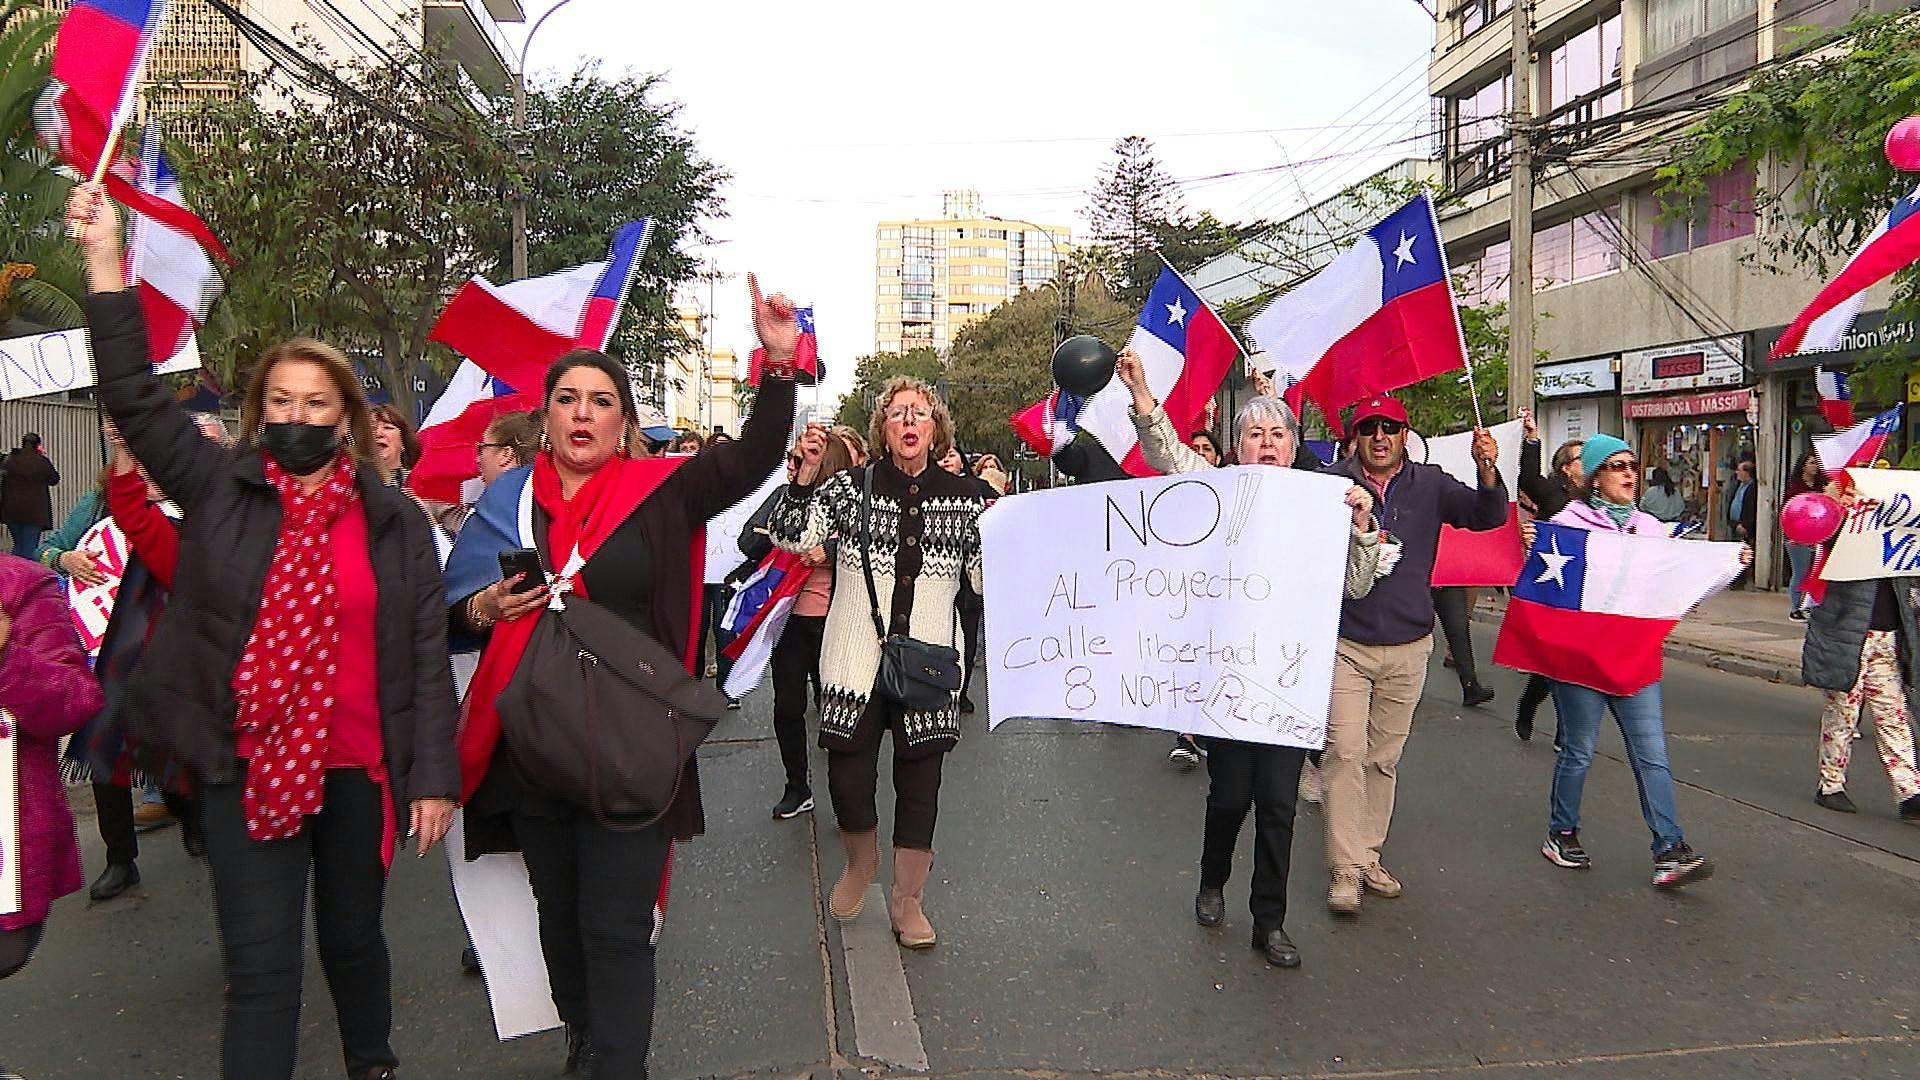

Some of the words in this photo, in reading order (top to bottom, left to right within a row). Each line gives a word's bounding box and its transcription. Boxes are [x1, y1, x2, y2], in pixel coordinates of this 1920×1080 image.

[0, 333, 76, 396] NO
[1044, 571, 1096, 617] AL
[1104, 558, 1271, 620] Proyecto
[1064, 665, 1097, 711] 8
